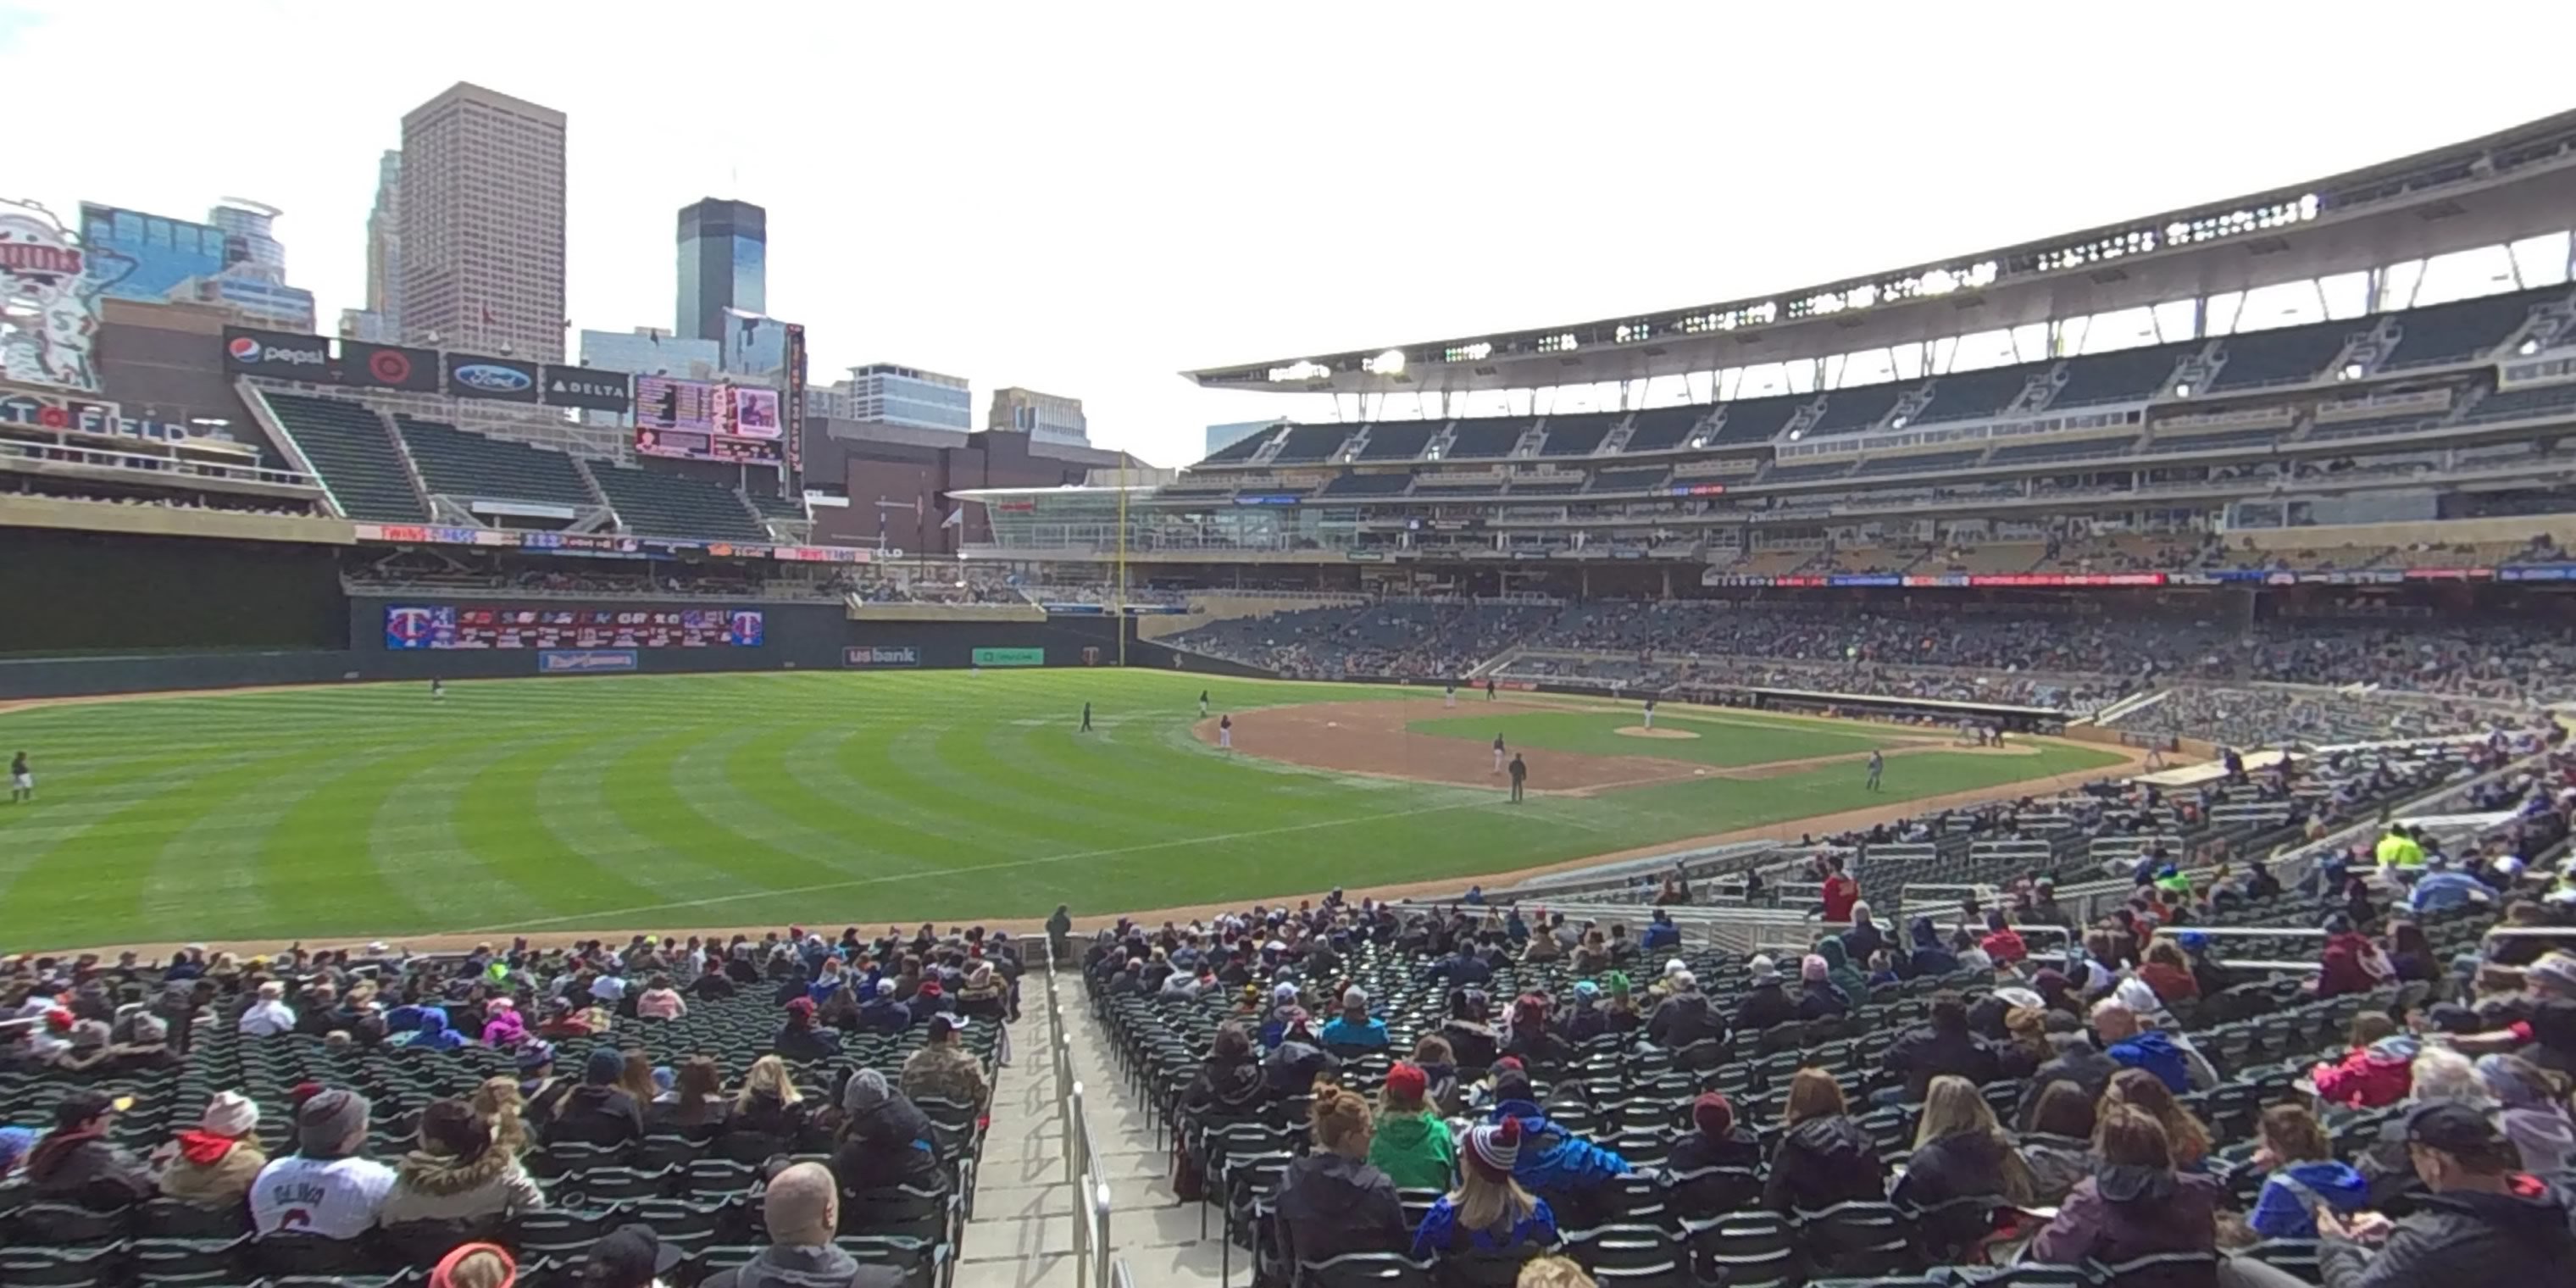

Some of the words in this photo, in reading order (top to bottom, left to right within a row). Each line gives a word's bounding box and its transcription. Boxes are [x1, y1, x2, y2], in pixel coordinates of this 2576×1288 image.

[264, 346, 325, 365] pepsi
[469, 369, 516, 388] Ford
[569, 381, 625, 398] DELTA
[79, 413, 189, 444] FIELD
